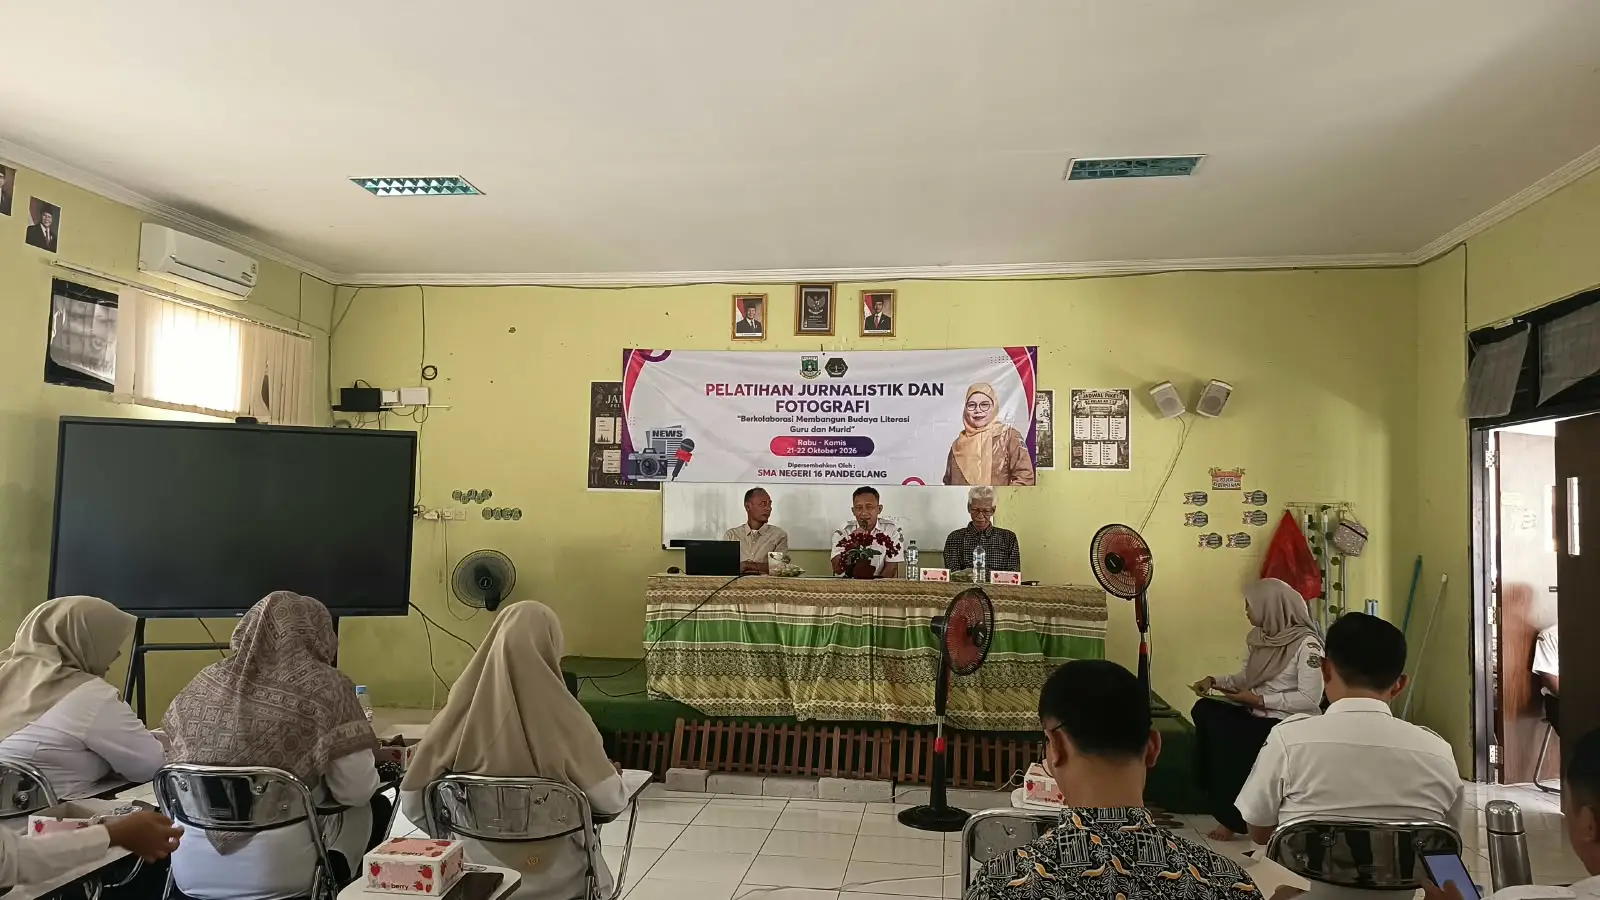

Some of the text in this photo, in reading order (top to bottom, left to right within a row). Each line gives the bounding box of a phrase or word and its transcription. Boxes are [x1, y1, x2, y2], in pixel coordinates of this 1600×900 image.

[705, 383, 944, 396] PELATIHAN JURNALISTIK DAN
[775, 400, 869, 413] FOTOGRAFI
[795, 415, 846, 424] Membangun
[847, 415, 878, 424] Budaya
[880, 415, 910, 423] Literasi
[824, 470, 888, 478] PANDEGLANG
